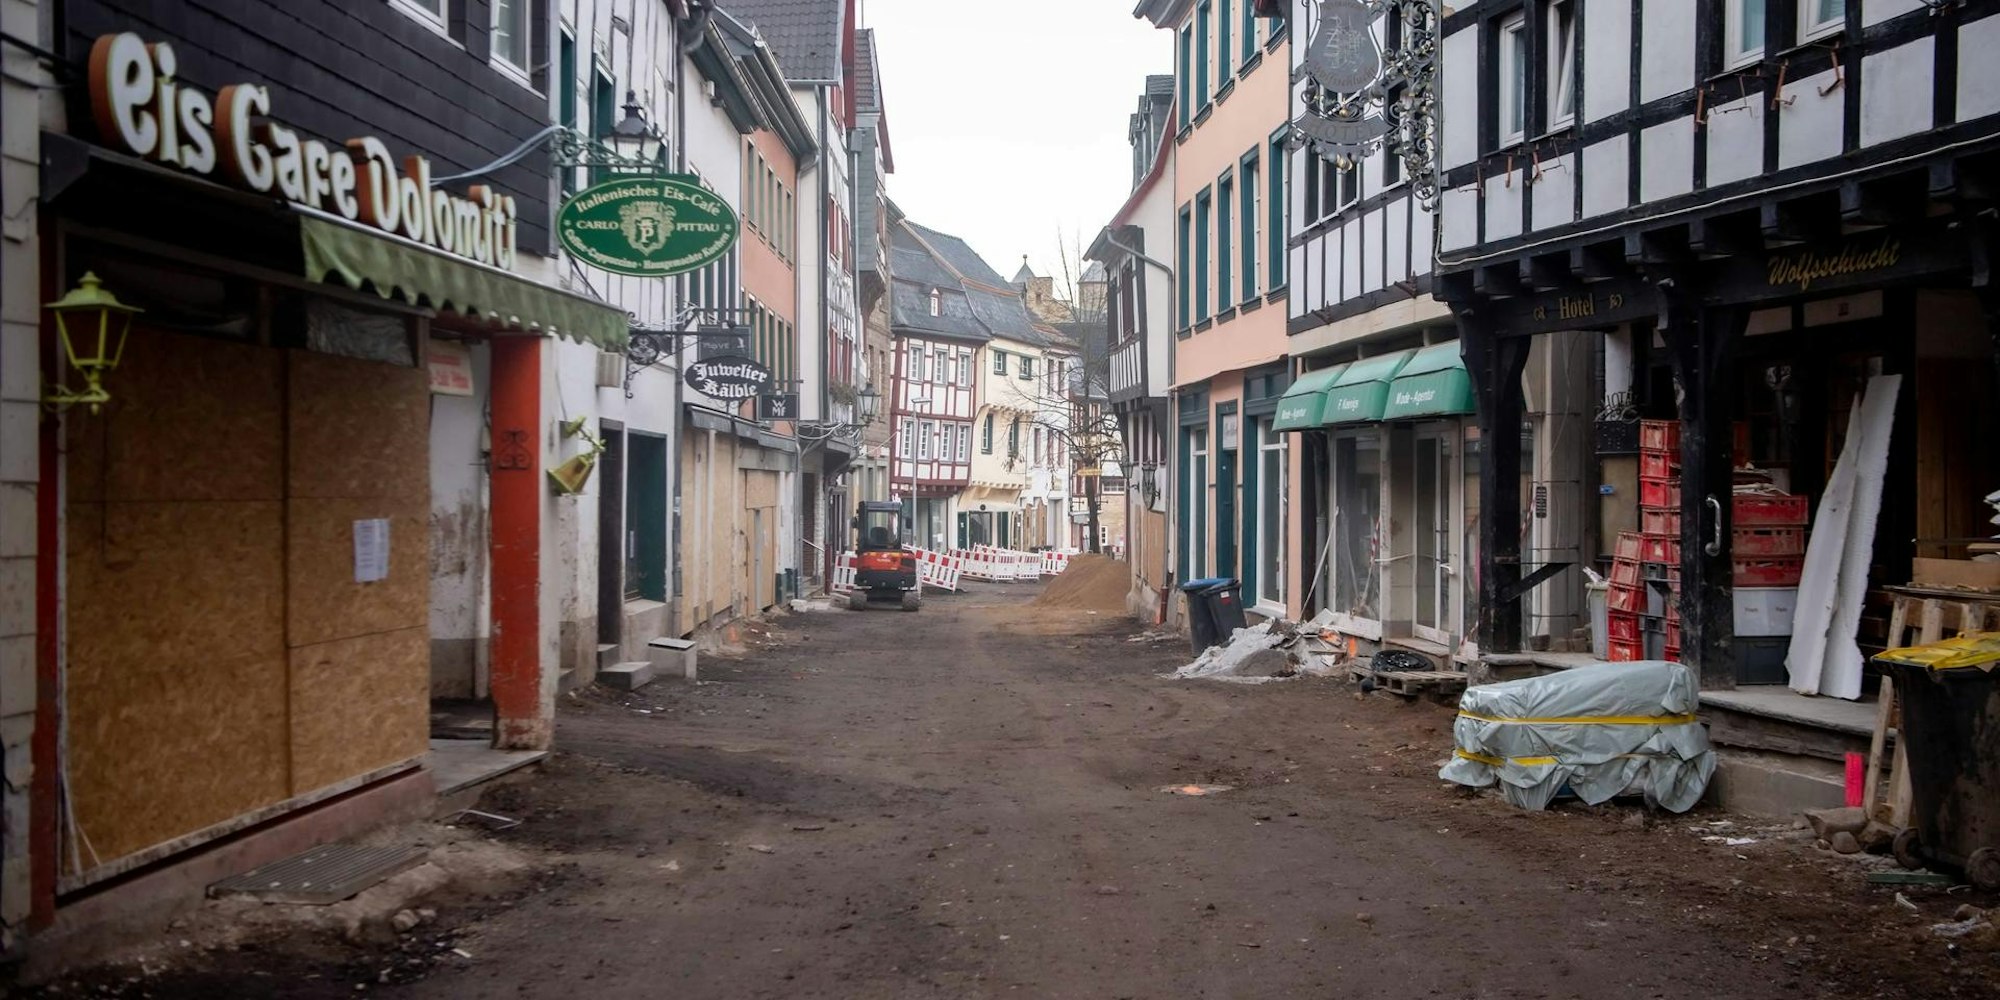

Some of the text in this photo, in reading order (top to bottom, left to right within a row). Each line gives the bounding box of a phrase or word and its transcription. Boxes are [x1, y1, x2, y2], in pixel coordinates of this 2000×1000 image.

[346, 136, 517, 270] Dolomiti
[575, 185, 720, 216] Italienisches Eis-Café
[576, 219, 619, 231] CARLO
[676, 222, 721, 233] PITTAU
[1768, 241, 1900, 290] Wolfsschlucht
[1559, 292, 1596, 320] Hotel
[693, 362, 768, 383] Juwelier
[699, 378, 759, 398] Kälble
